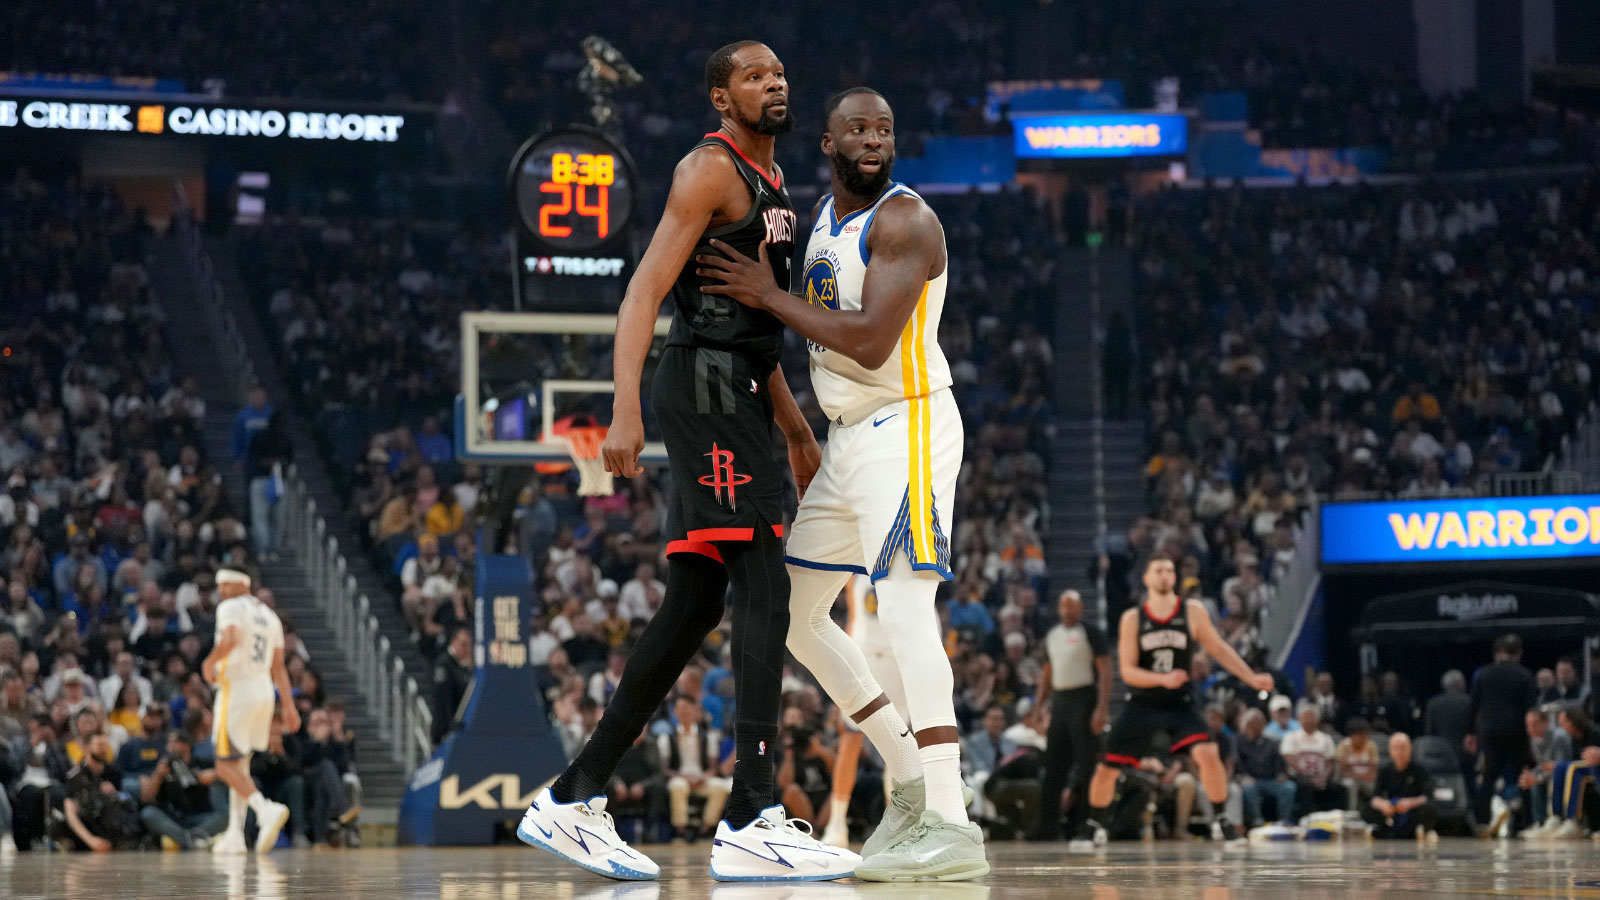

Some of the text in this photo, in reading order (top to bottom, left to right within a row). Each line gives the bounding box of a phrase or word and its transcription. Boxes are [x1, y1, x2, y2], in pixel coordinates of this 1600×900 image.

[22, 101, 133, 132] CREEK
[168, 106, 286, 137] CASINO
[288, 111, 404, 142] RESORT
[1024, 124, 1161, 149] WARRIORS
[552, 153, 614, 186] 8:38
[539, 182, 609, 238] 24
[551, 257, 625, 276] TISSOT
[820, 278, 835, 301] 23
